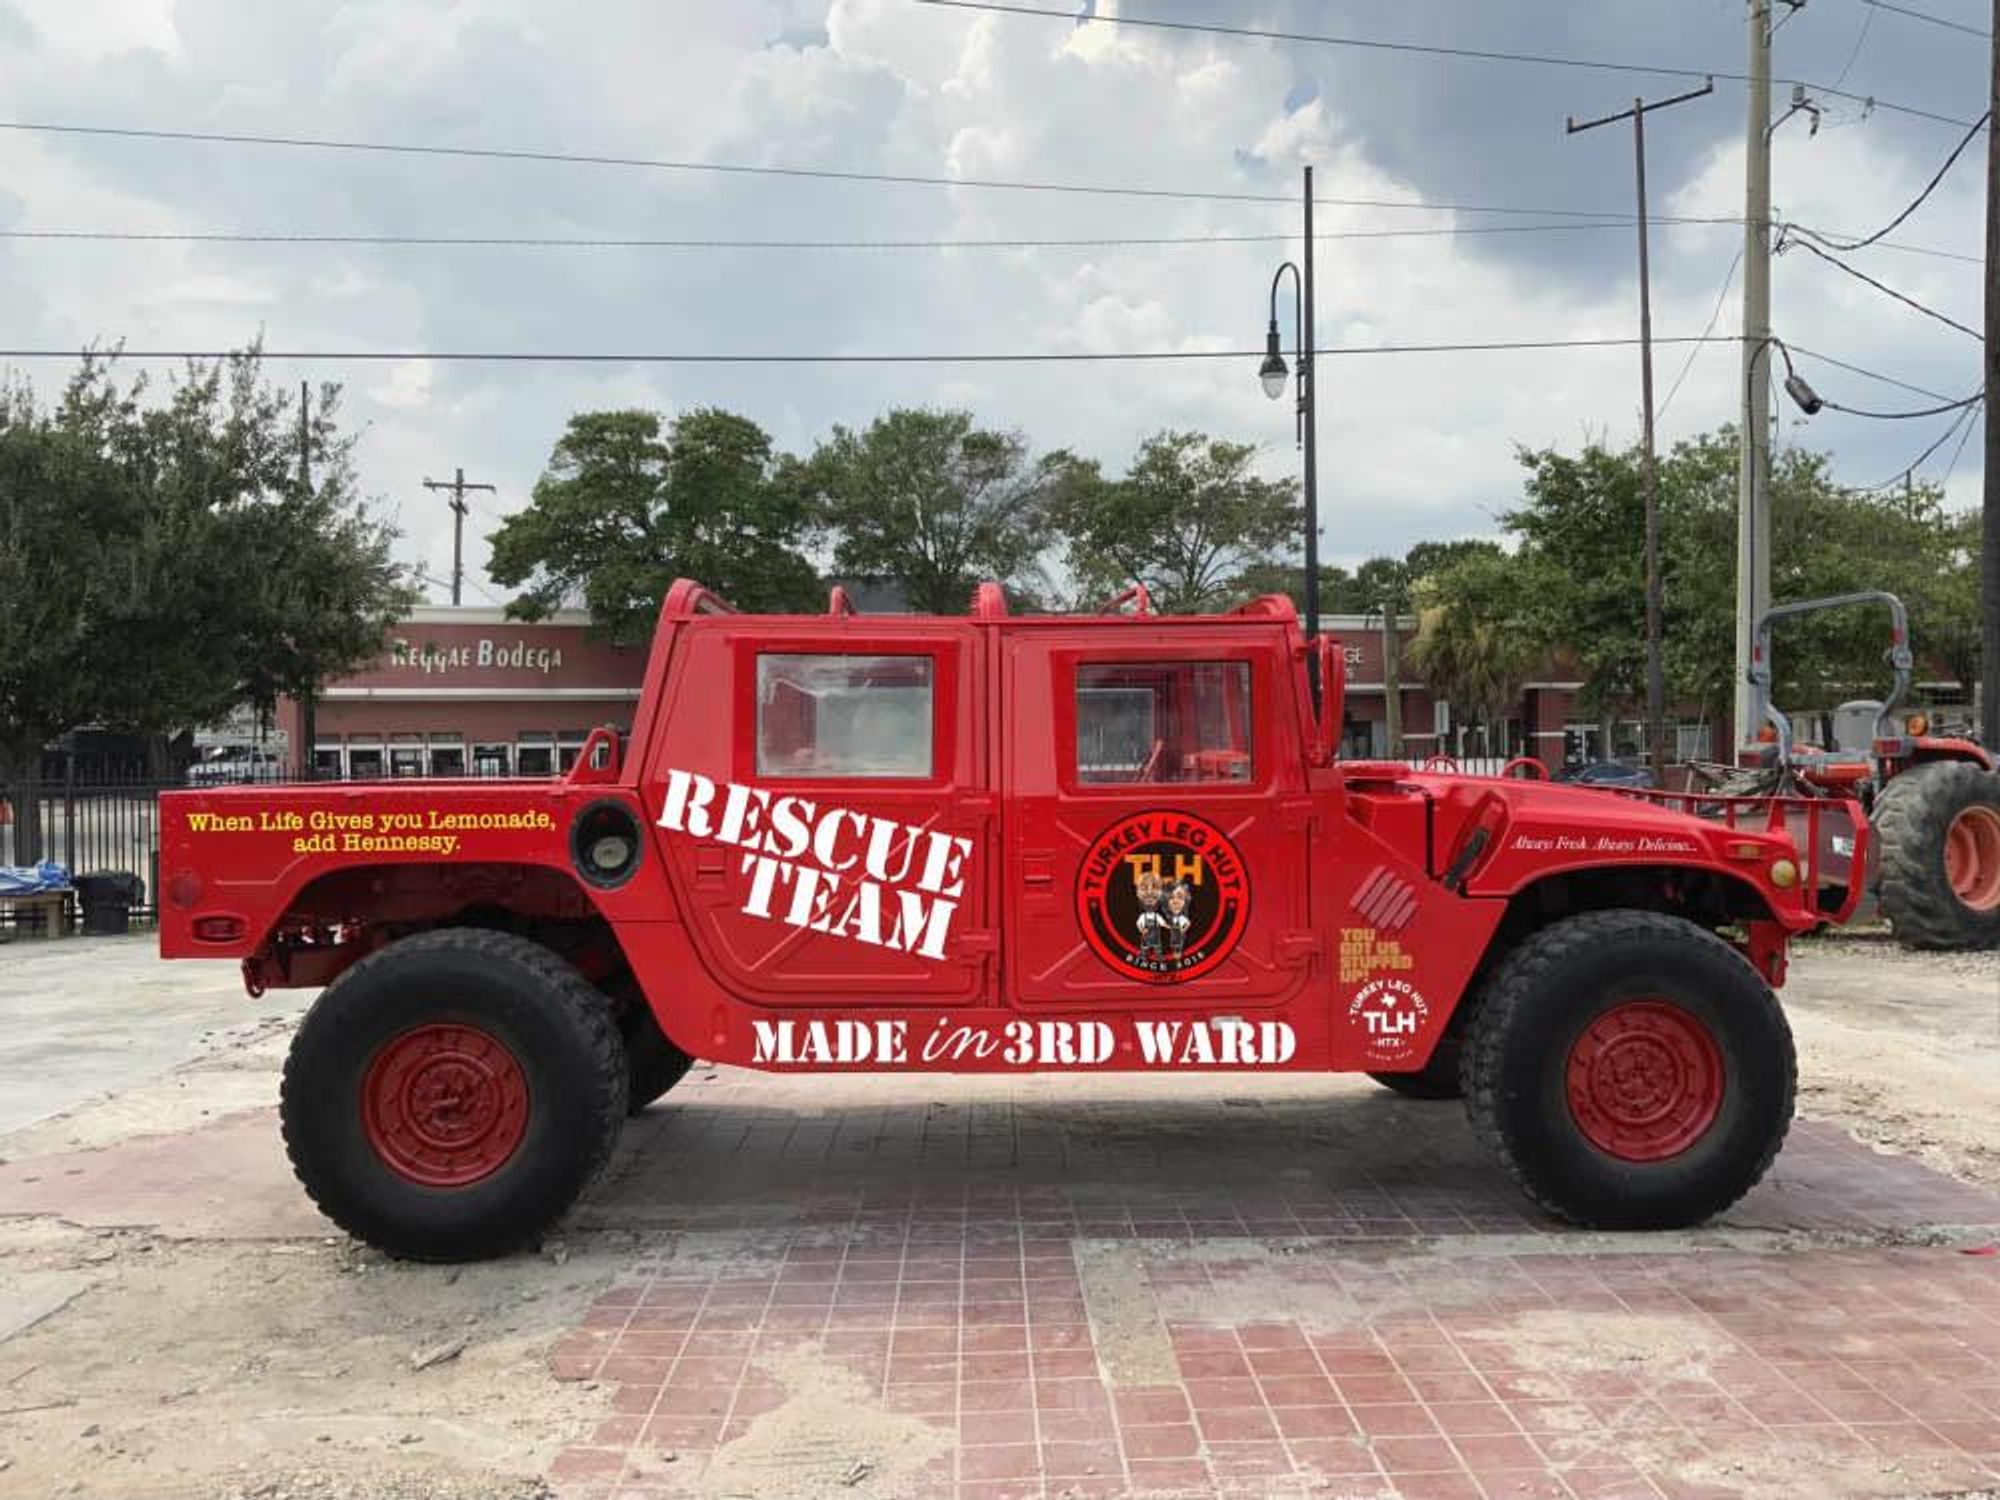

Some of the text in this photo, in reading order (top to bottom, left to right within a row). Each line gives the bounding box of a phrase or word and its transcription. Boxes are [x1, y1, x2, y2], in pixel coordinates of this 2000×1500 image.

[187, 811, 557, 834] When Life Gives you Lemonade,
[656, 768, 973, 898] RESCUE
[293, 834, 462, 856] add Hennessy.
[1085, 818, 1241, 891] TURKEY LEG HUT
[1124, 853, 1205, 886] TLH
[740, 853, 958, 961] TEAM
[1340, 928, 1376, 942] YOU
[1349, 979, 1429, 1016] TURKEY LEG HUT
[1362, 1010, 1416, 1034] TLH
[752, 1016, 1297, 1065] MADE in 3RD WARD
